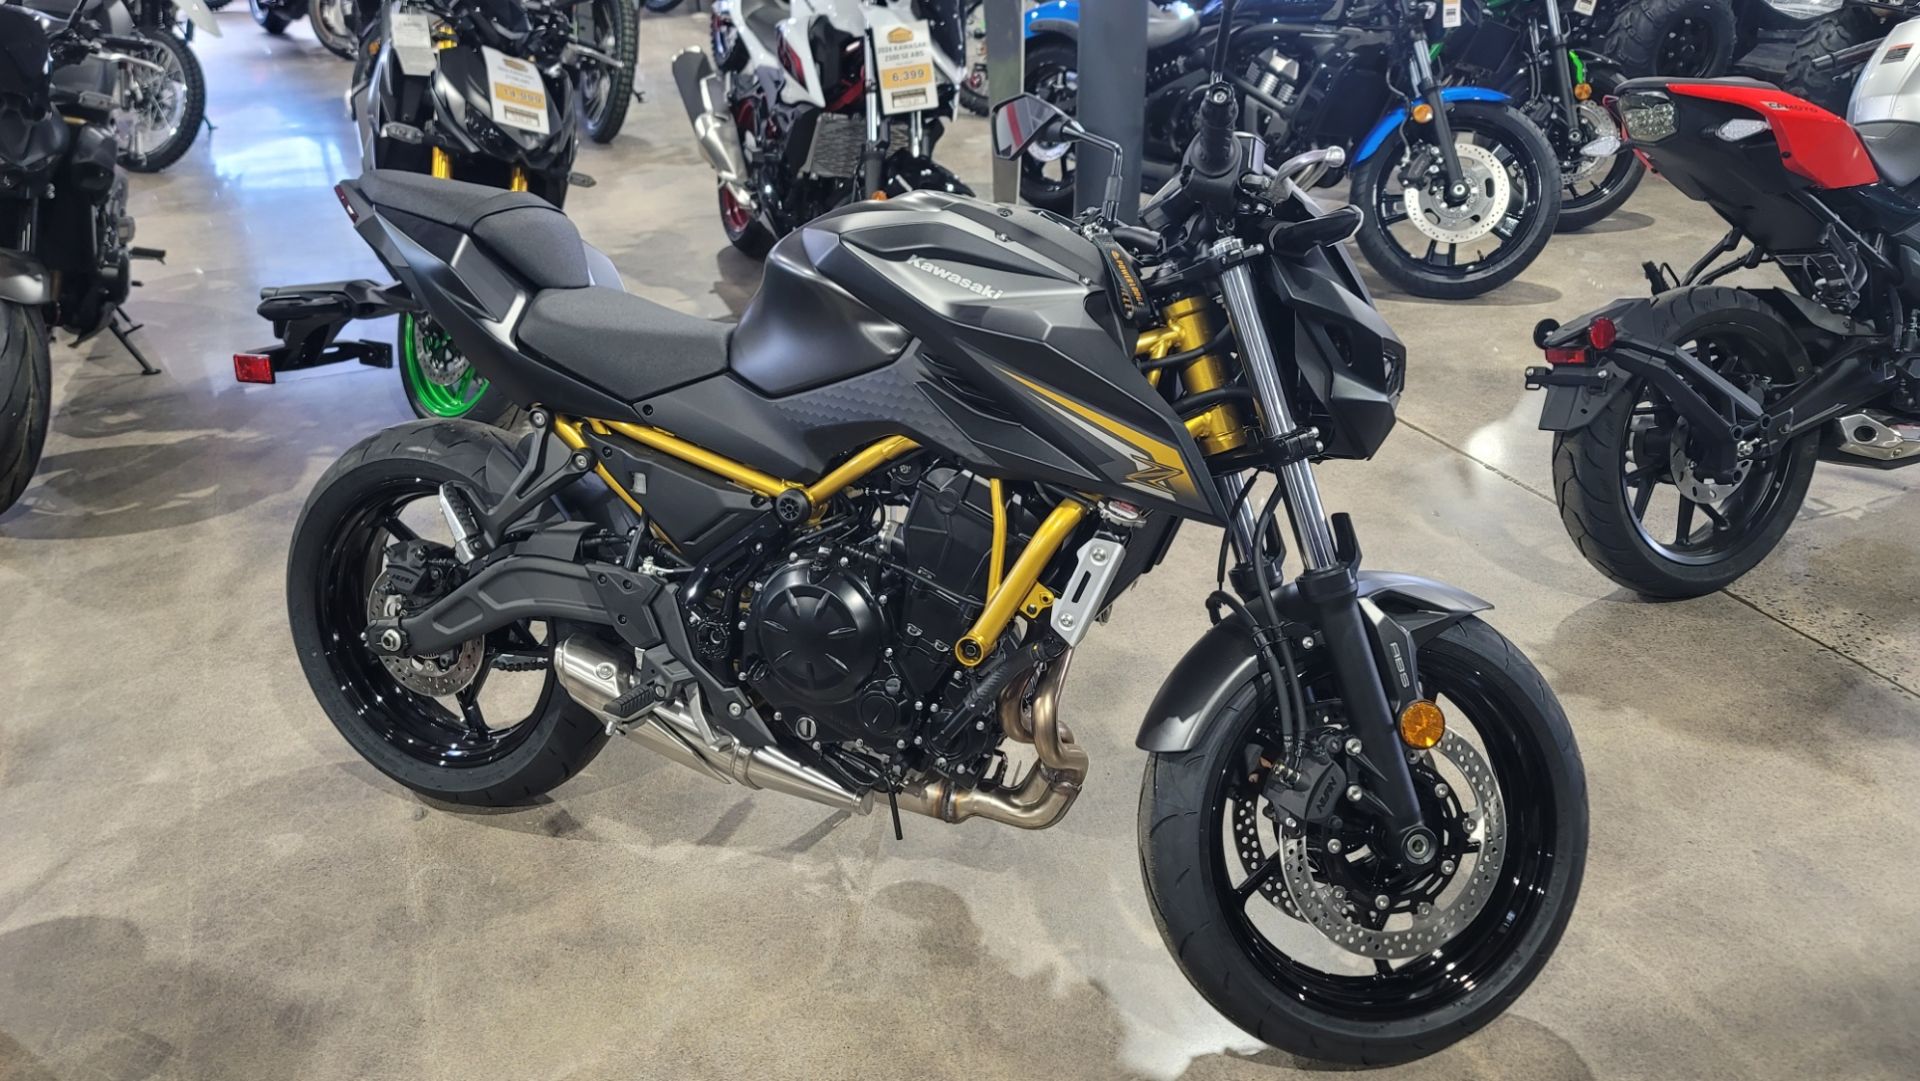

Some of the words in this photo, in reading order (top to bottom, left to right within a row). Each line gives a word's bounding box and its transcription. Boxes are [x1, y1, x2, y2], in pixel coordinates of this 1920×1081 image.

[910, 50, 925, 58] ABS
[892, 69, 925, 82] 6,399
[906, 253, 1004, 300] Kawasaki
[1389, 641, 1410, 689] ABS
